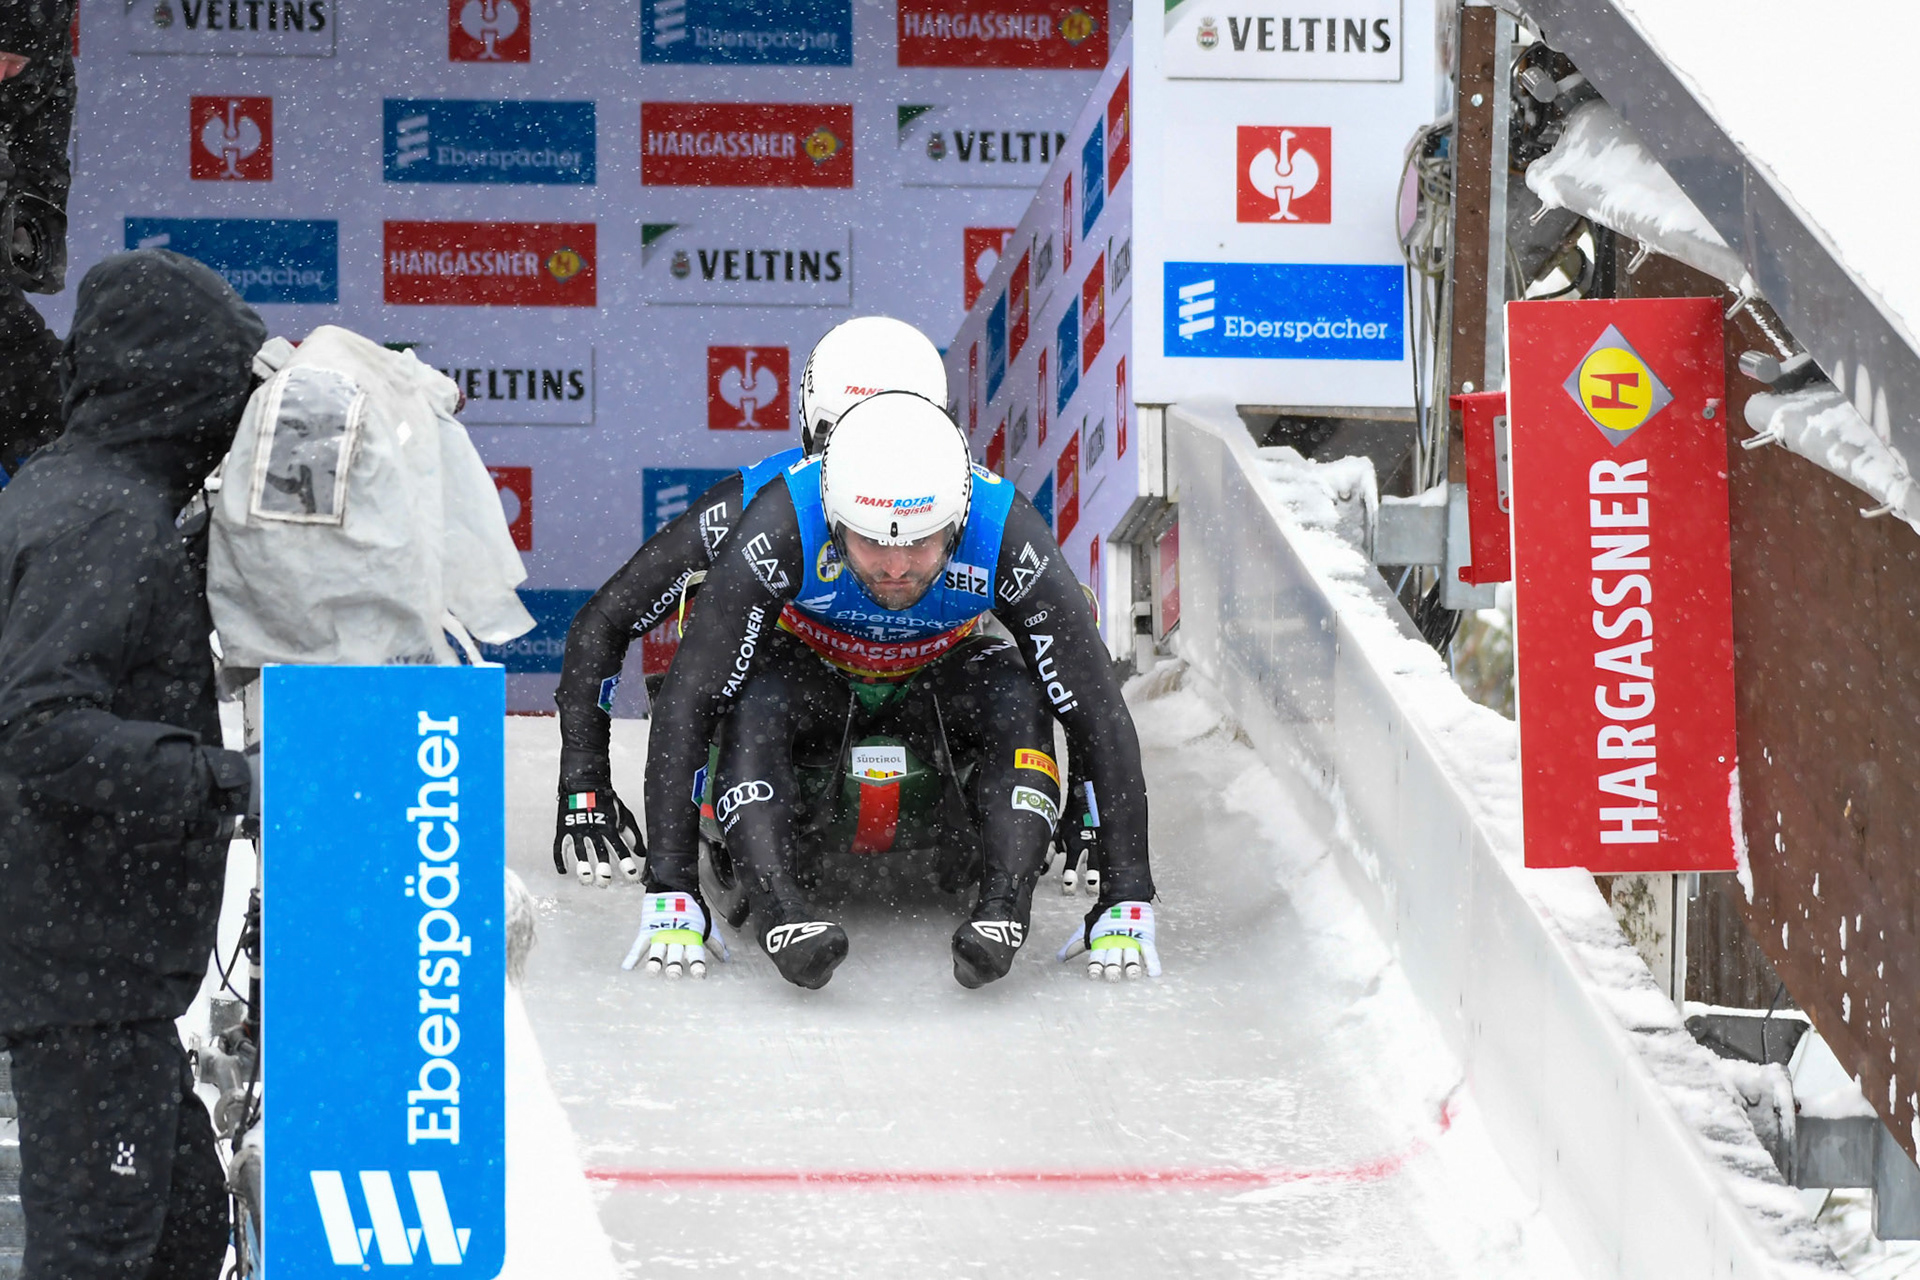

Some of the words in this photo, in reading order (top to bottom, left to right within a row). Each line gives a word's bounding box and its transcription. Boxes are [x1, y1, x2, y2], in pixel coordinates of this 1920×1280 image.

[180, 0, 326, 31] VELTINS
[904, 14, 1052, 39] HARGASSNER
[694, 26, 840, 50] Eberspächer
[1228, 17, 1392, 53] VELTINS
[436, 145, 582, 169] Eberspächer
[648, 131, 796, 158] HARGASSNER
[955, 131, 1066, 163] VELTI
[389, 251, 539, 276] HARGASSNER
[698, 249, 842, 282] VELTINS
[1223, 316, 1388, 342] Eberspächer
[893, 504, 933, 516] logistik
[746, 532, 790, 589] EA7
[999, 541, 1041, 602] EA7
[722, 606, 765, 698] FALCONERI
[1589, 458, 1660, 845] HARGASSNER
[1030, 633, 1079, 714] Audi
[724, 813, 741, 837] Audi
[406, 711, 471, 1145] Eberspächer
[766, 921, 835, 954] GTS
[971, 920, 1023, 948] GTS
